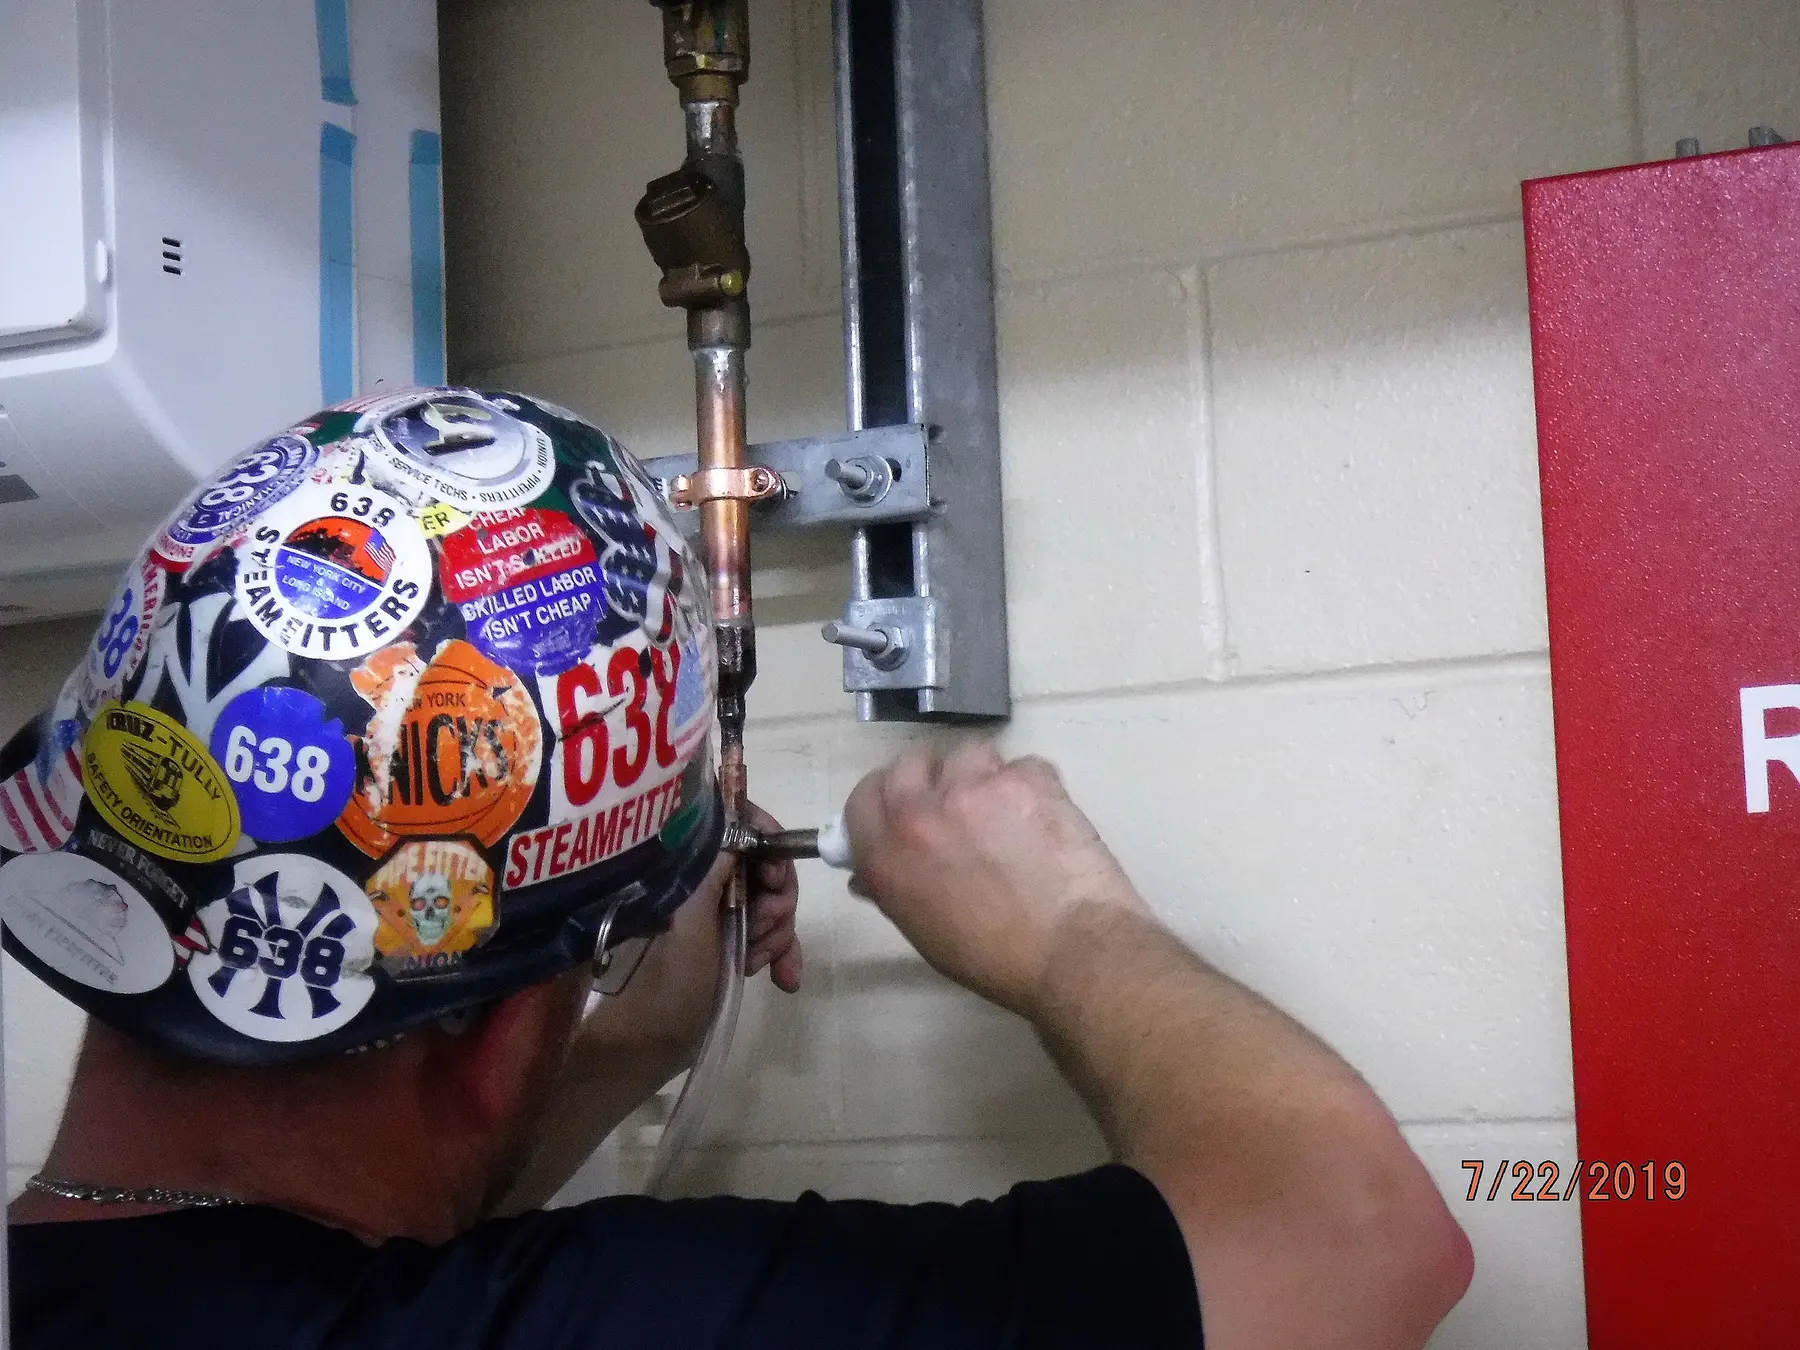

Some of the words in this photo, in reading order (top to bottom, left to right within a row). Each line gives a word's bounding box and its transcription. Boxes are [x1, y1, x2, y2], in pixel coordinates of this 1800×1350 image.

[536, 437, 548, 472] UNION
[388, 456, 432, 485] SERVICE
[434, 478, 468, 502] TECHS
[479, 473, 541, 503] PIPEFITTERS
[330, 492, 396, 528] 638
[477, 522, 545, 555] LABOR
[281, 574, 311, 592] LONG
[286, 555, 311, 569] NEW
[312, 563, 340, 583] YORK
[341, 577, 366, 594] CITY
[538, 566, 598, 597] LABOR
[483, 610, 533, 641] ISN'T
[536, 592, 592, 625] CHEAP
[426, 692, 467, 708] YORK
[225, 724, 330, 803] 638
[1739, 683, 1800, 814] R
[86, 752, 123, 807] SAFETY
[121, 806, 213, 848] ORIENTATION
[218, 913, 346, 990] 638
